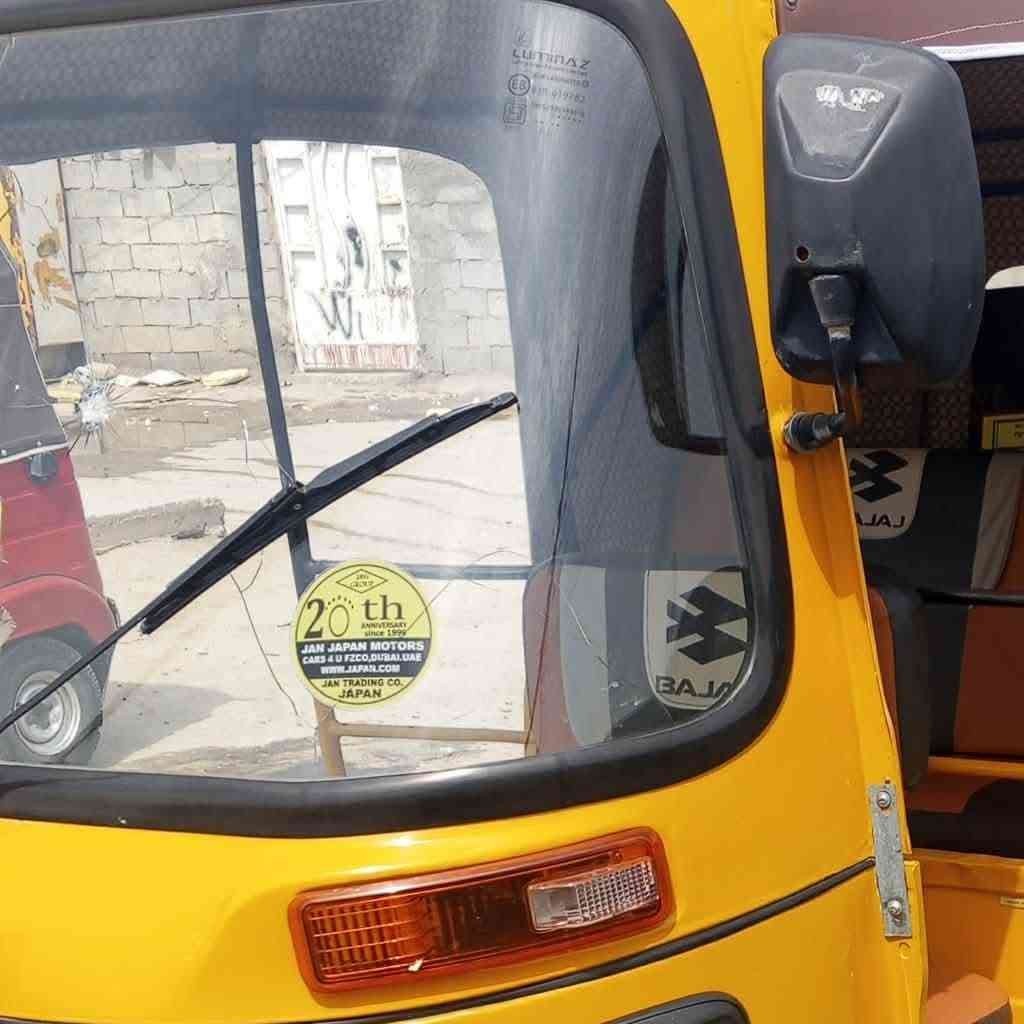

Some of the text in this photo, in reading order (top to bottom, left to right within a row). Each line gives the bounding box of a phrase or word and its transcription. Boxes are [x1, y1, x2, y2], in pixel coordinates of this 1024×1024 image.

[301, 640, 425, 654] JAN JAPAN MOTORS
[302, 655, 326, 664] CARS
[321, 677, 404, 688] JAN TRADING CO.
[655, 675, 735, 699] BAJA
[338, 688, 382, 699] JAPAN
